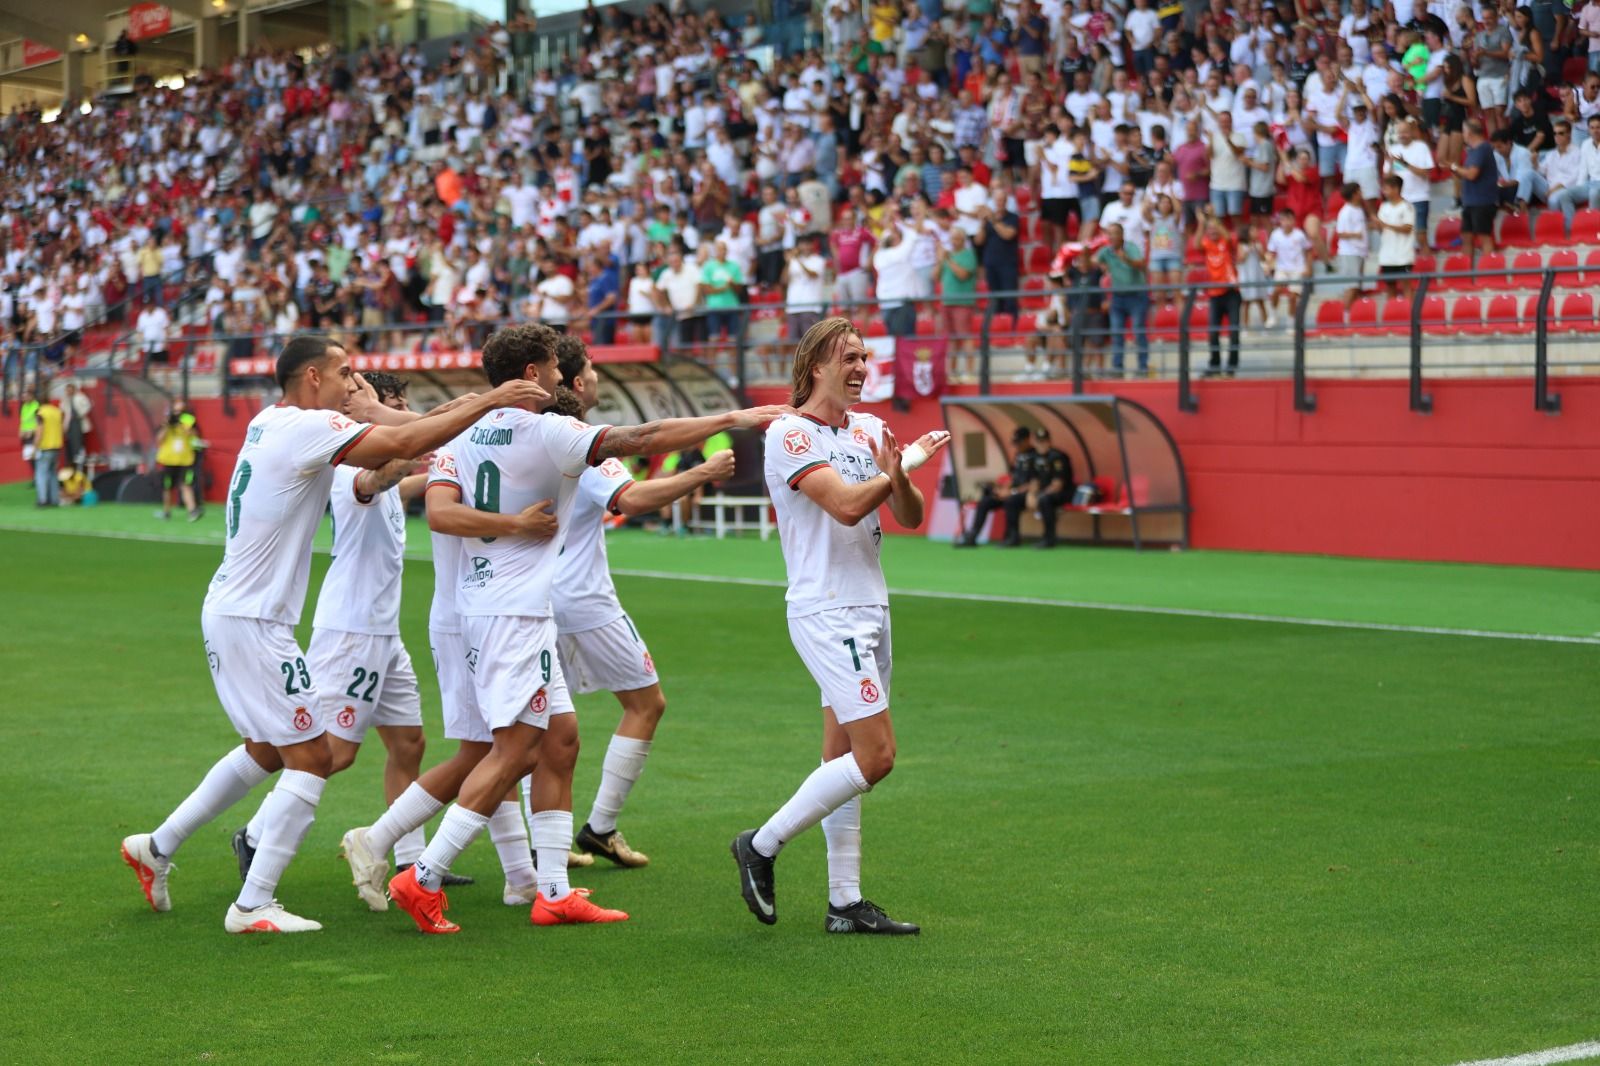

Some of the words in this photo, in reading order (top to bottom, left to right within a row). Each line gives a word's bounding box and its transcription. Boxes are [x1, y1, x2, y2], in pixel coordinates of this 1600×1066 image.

[281, 657, 311, 696] 23
[541, 650, 551, 683] 9
[346, 667, 379, 703] 22
